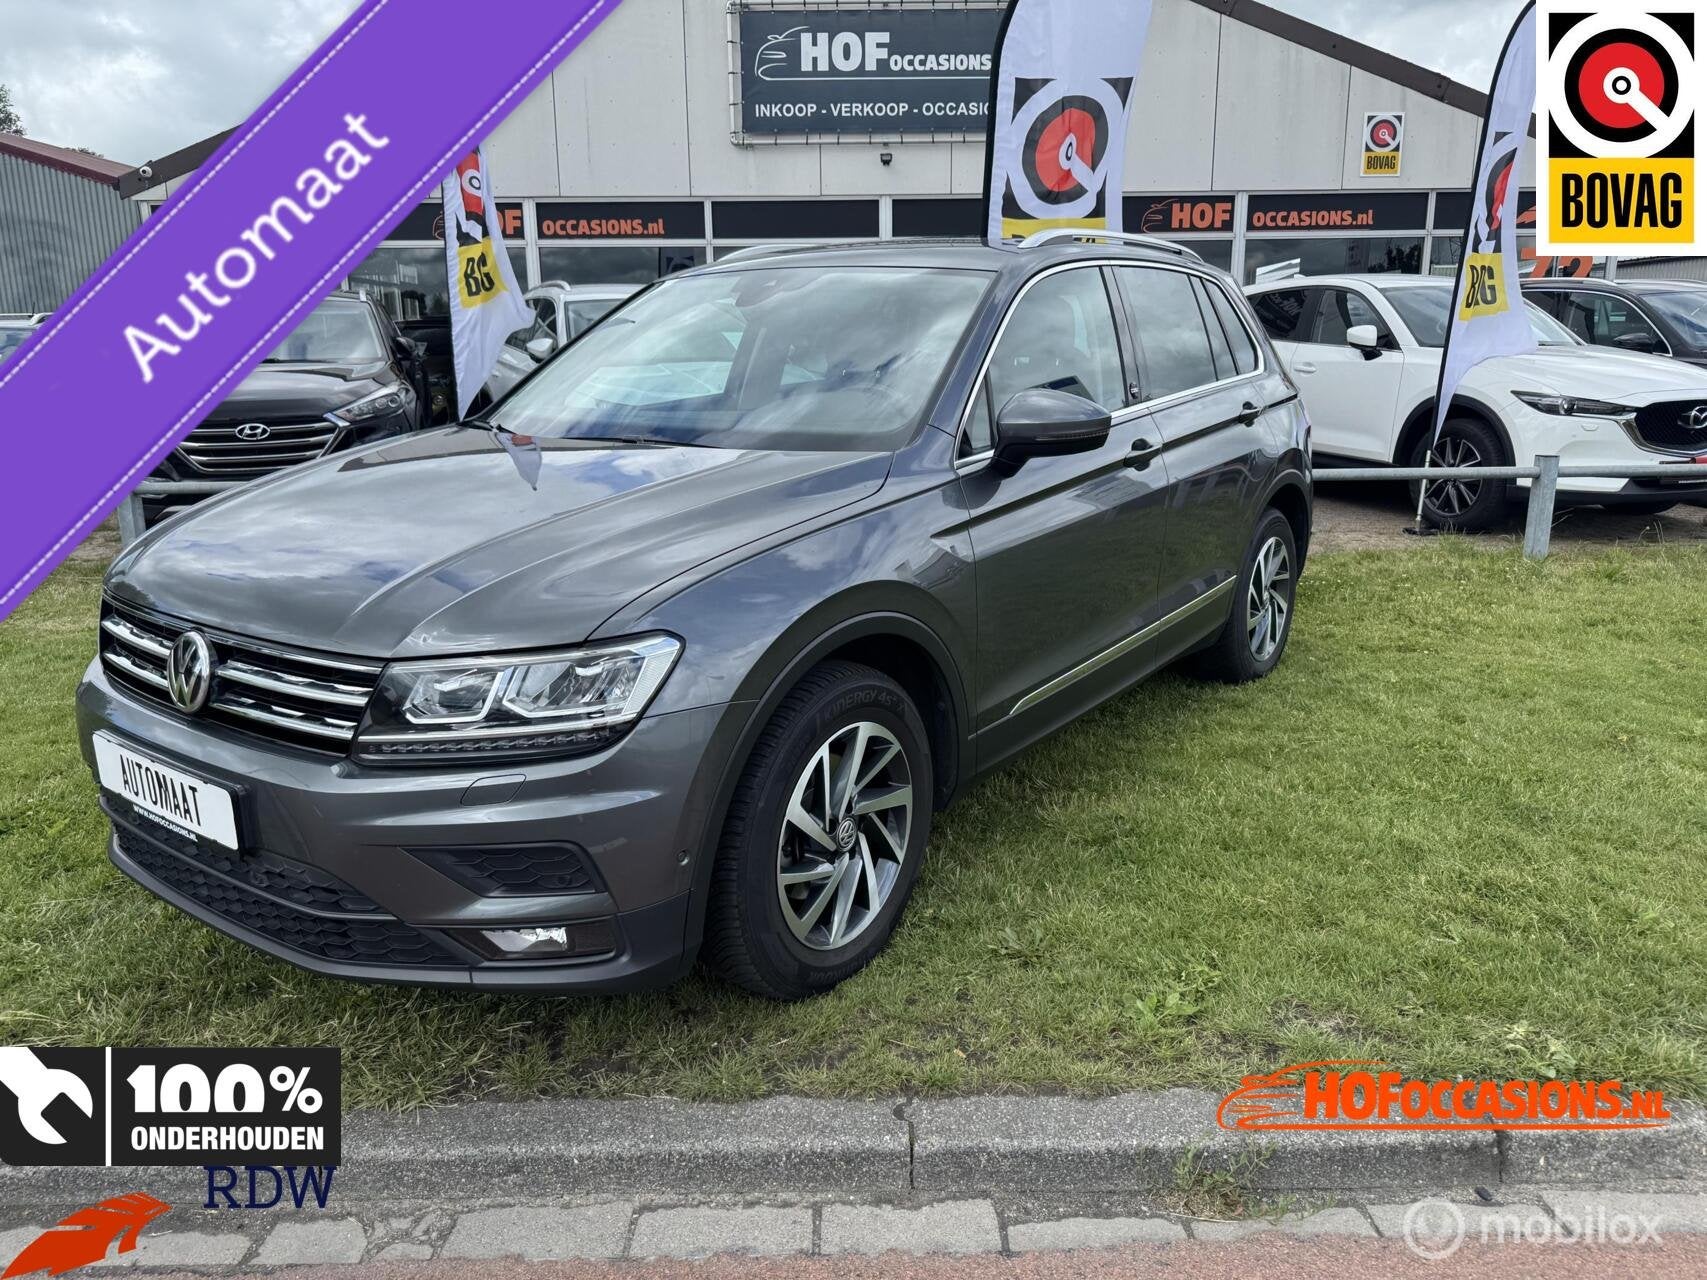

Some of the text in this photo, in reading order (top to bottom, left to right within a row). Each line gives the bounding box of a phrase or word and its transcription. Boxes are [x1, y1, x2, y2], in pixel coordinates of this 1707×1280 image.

[755, 103, 817, 117] INKOOP
[830, 102, 908, 117] VERKOOP
[1366, 155, 1396, 170] BOVAG
[1170, 202, 1374, 229] HOF OCCASIONS.nl
[542, 218, 665, 236] OCCASIONS.nl
[120, 754, 201, 827] AUTOMAAT
